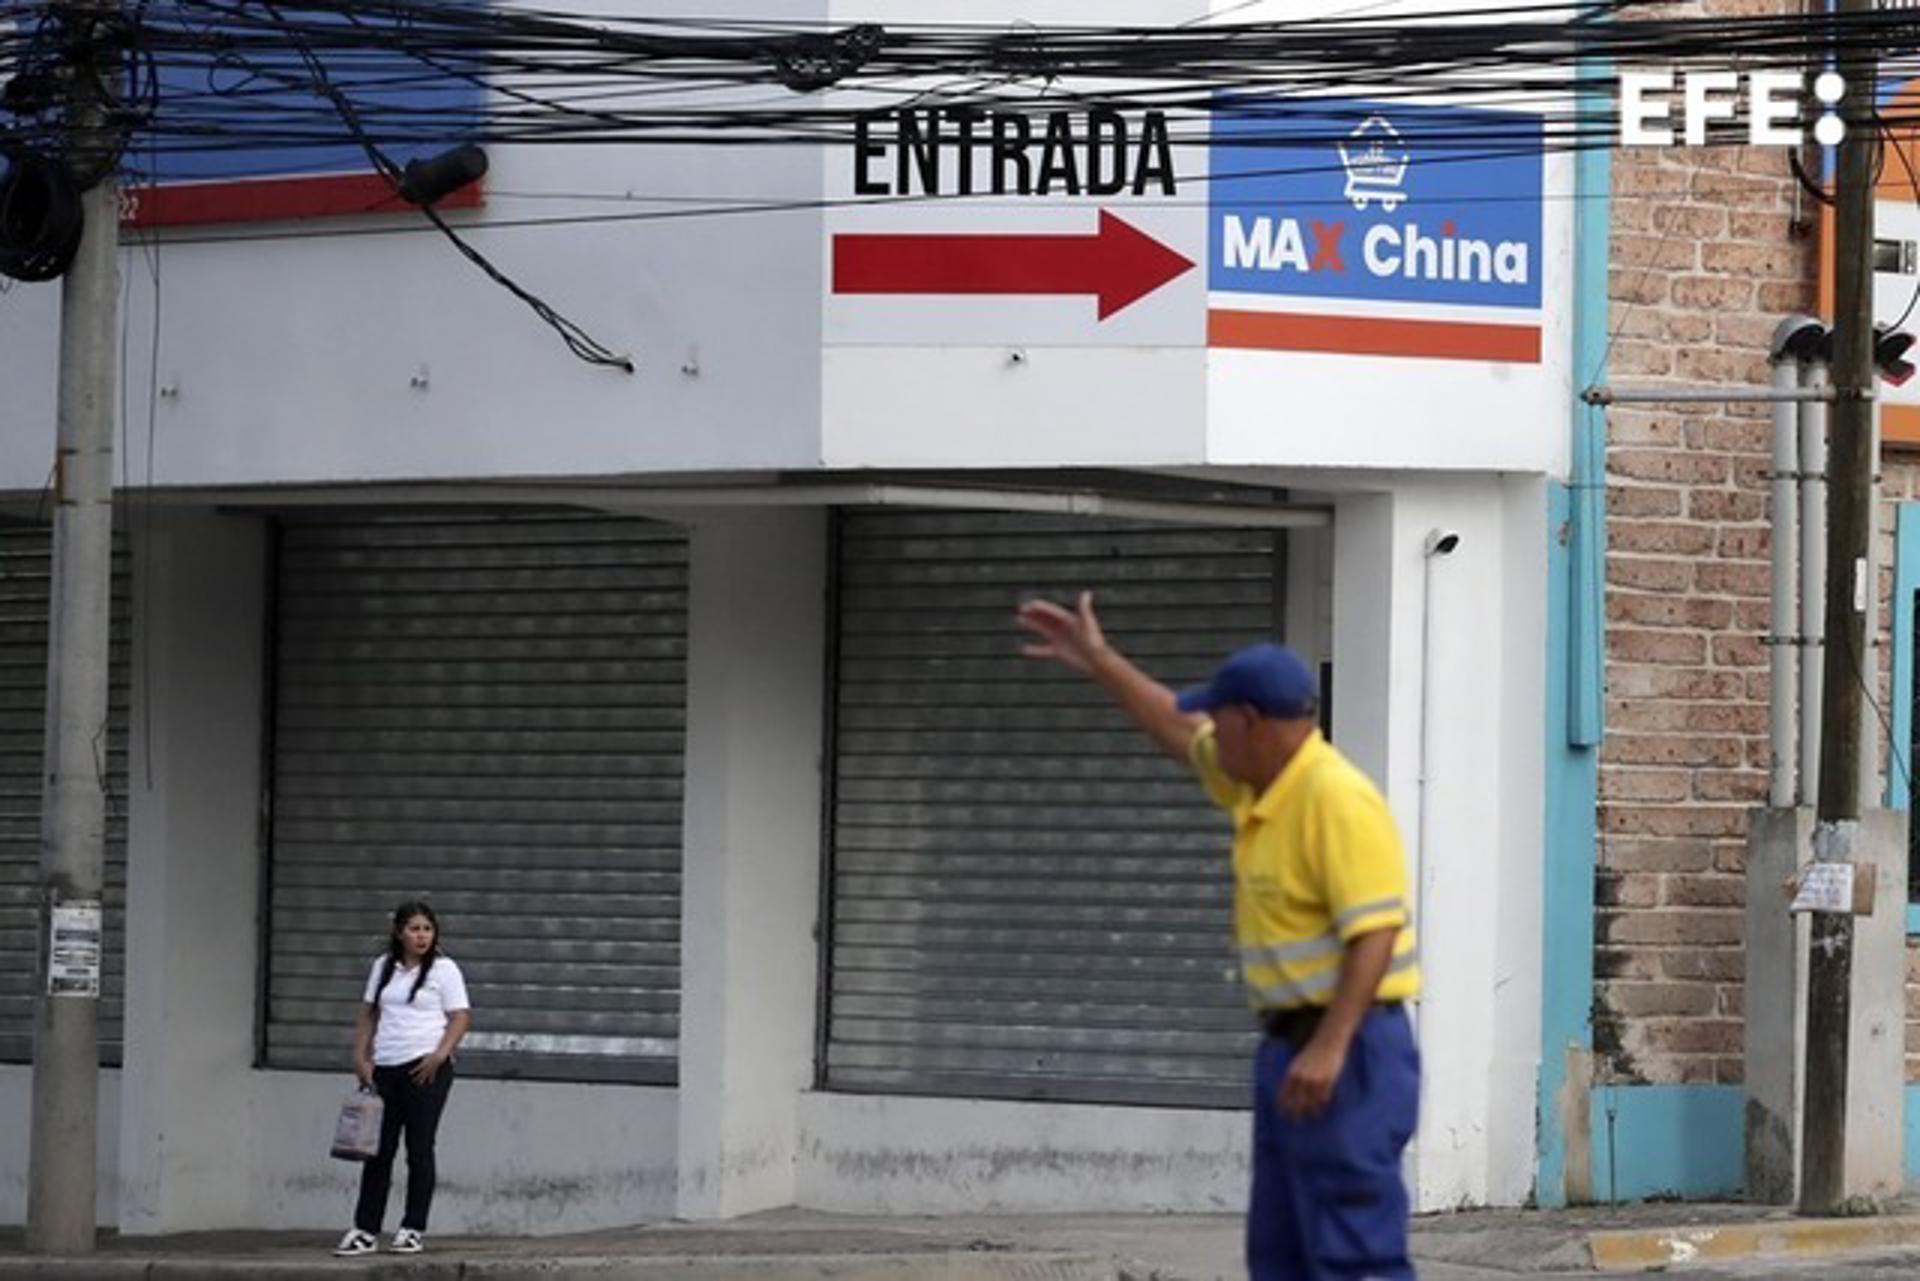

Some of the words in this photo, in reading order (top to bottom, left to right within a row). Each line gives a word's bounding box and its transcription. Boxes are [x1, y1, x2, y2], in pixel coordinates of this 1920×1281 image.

[854, 109, 1177, 196] ENTRADA
[1223, 215, 1345, 272] MAX
[1363, 219, 1528, 284] China
